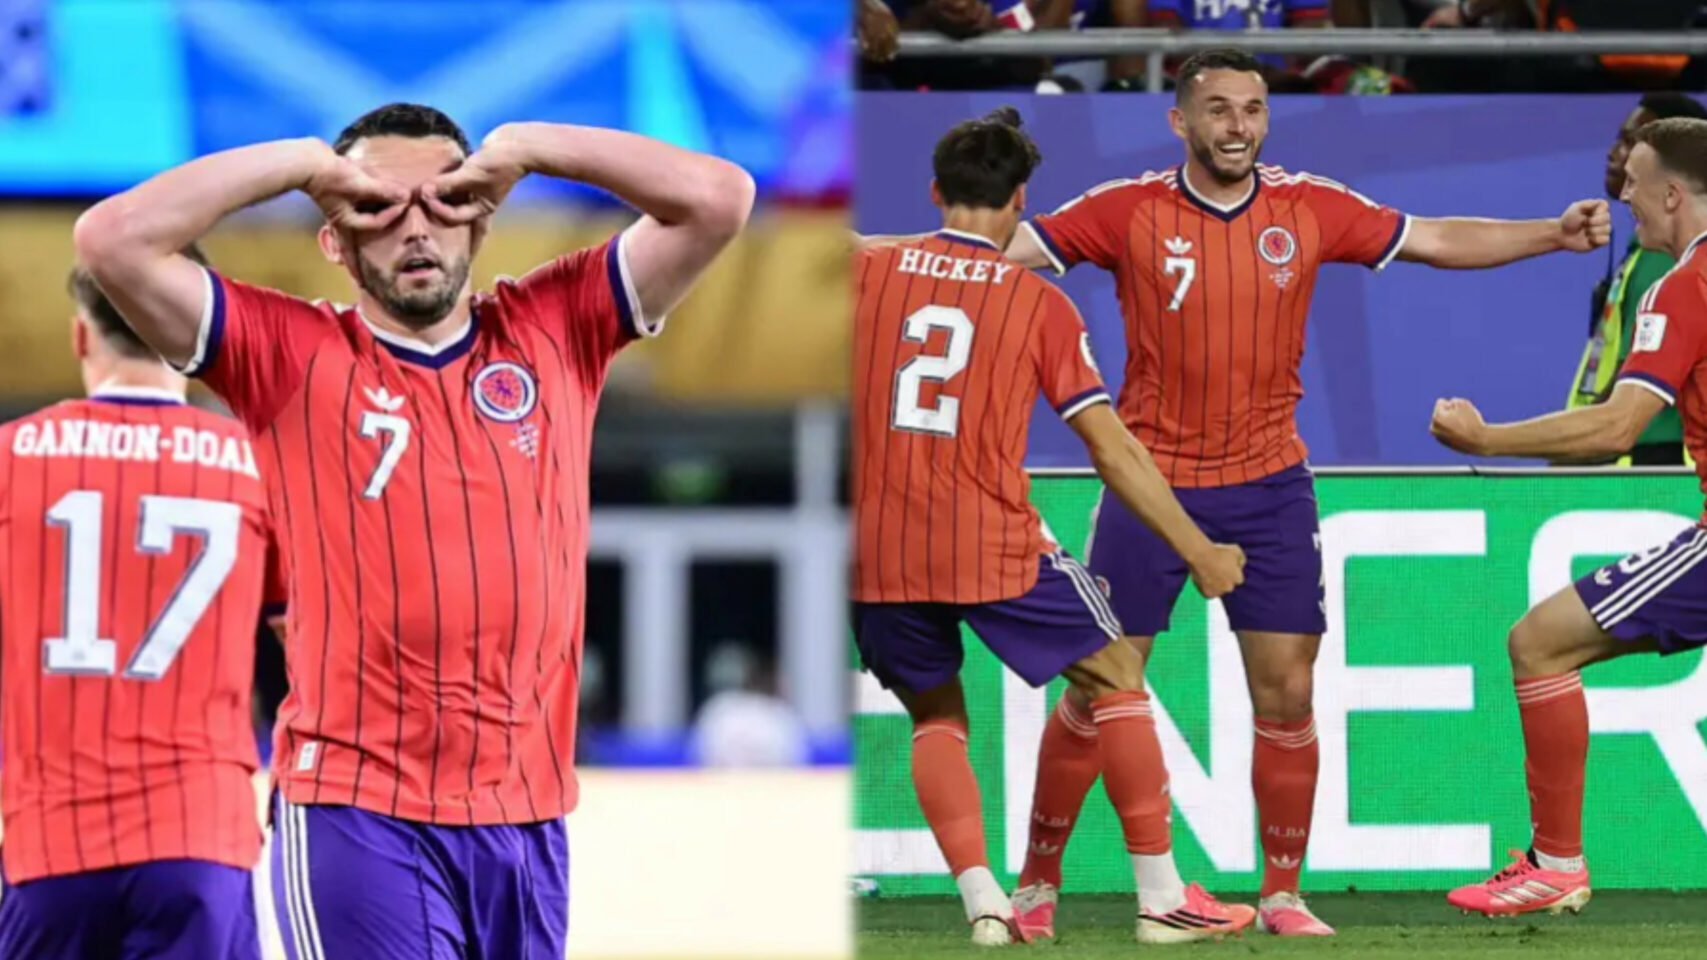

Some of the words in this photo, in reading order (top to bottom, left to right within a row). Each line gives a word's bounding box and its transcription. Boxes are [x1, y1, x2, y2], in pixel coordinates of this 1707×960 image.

[898, 248, 1013, 284] HICKEY
[1164, 258, 1196, 311] 7
[892, 305, 974, 437] 2
[359, 412, 411, 499] 7
[44, 490, 241, 679] 17
